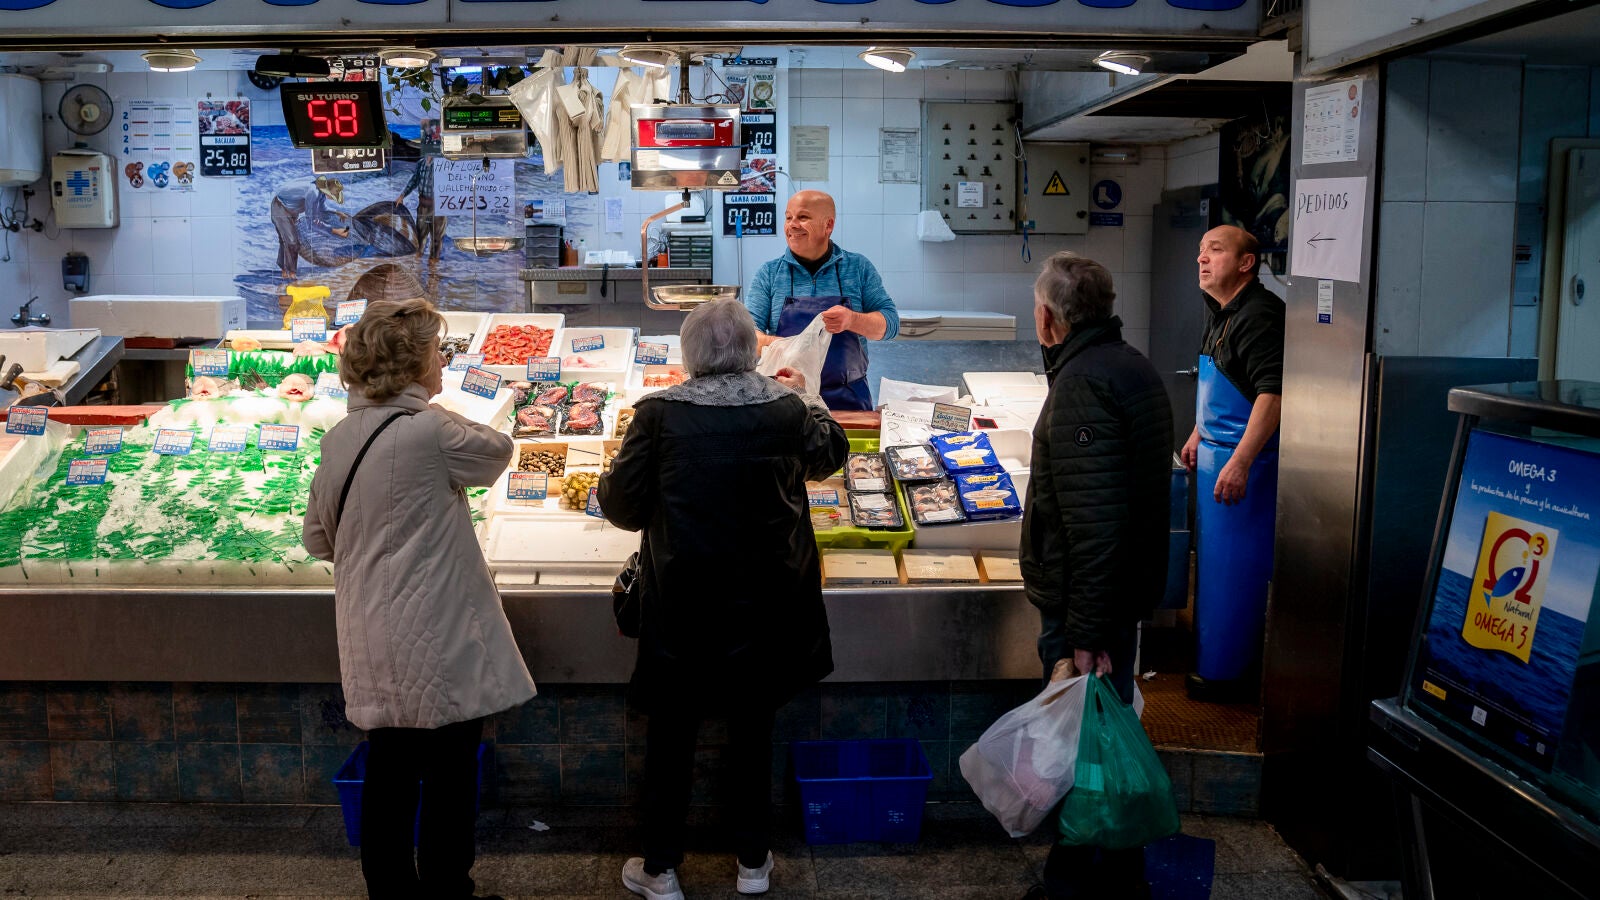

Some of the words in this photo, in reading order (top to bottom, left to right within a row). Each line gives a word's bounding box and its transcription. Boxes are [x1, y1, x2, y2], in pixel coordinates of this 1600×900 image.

[307, 100, 358, 138] 58
[204, 149, 247, 168] 25,80
[728, 208, 772, 226] 00,00
[1508, 460, 1544, 481] OMEGA
[1546, 469, 1557, 482] 3
[1478, 484, 1504, 498] productos
[1504, 490, 1513, 500] de
[1514, 490, 1520, 501] la
[1520, 496, 1538, 506] pesca
[1538, 501, 1544, 512] y
[1544, 498, 1550, 509] la
[1524, 483, 1531, 494] y
[1532, 537, 1545, 556] 3
[1504, 601, 1534, 620] Natural
[1474, 612, 1514, 642] OMEGA
[1516, 625, 1528, 650] 3
